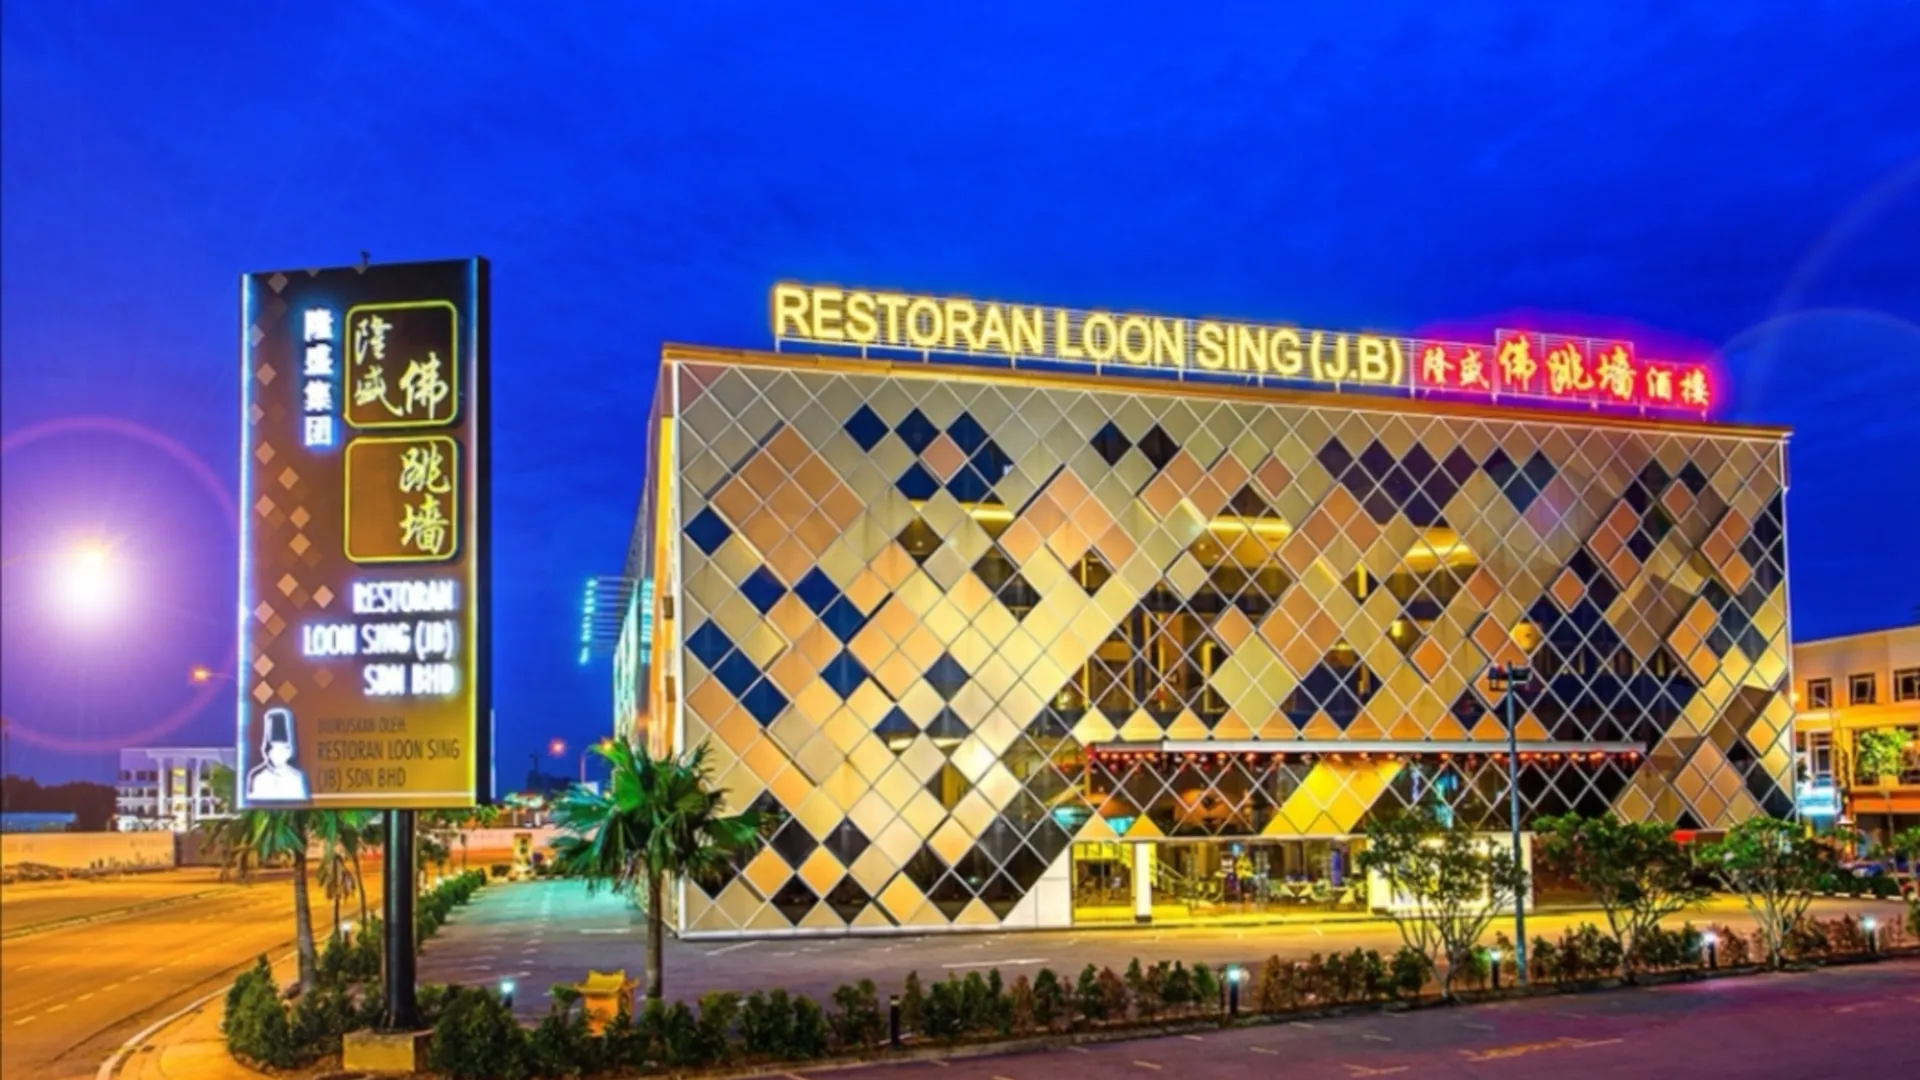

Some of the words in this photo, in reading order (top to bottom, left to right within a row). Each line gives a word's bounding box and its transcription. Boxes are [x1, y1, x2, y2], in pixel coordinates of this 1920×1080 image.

[774, 284, 1043, 354] RESTORAN
[1055, 310, 1184, 367] LOON
[1196, 322, 1303, 377] SING
[1310, 331, 1404, 387] (J.B)
[352, 580, 454, 614] RESTORAN
[303, 623, 357, 656] LOON
[361, 621, 412, 655] SING
[363, 663, 406, 696] SDN
[411, 662, 458, 695] BHD
[317, 740, 383, 760] RESTORAN
[387, 739, 423, 760] LOON
[428, 738, 460, 760] SING
[346, 767, 373, 788] SDN
[377, 766, 406, 788] BHD
